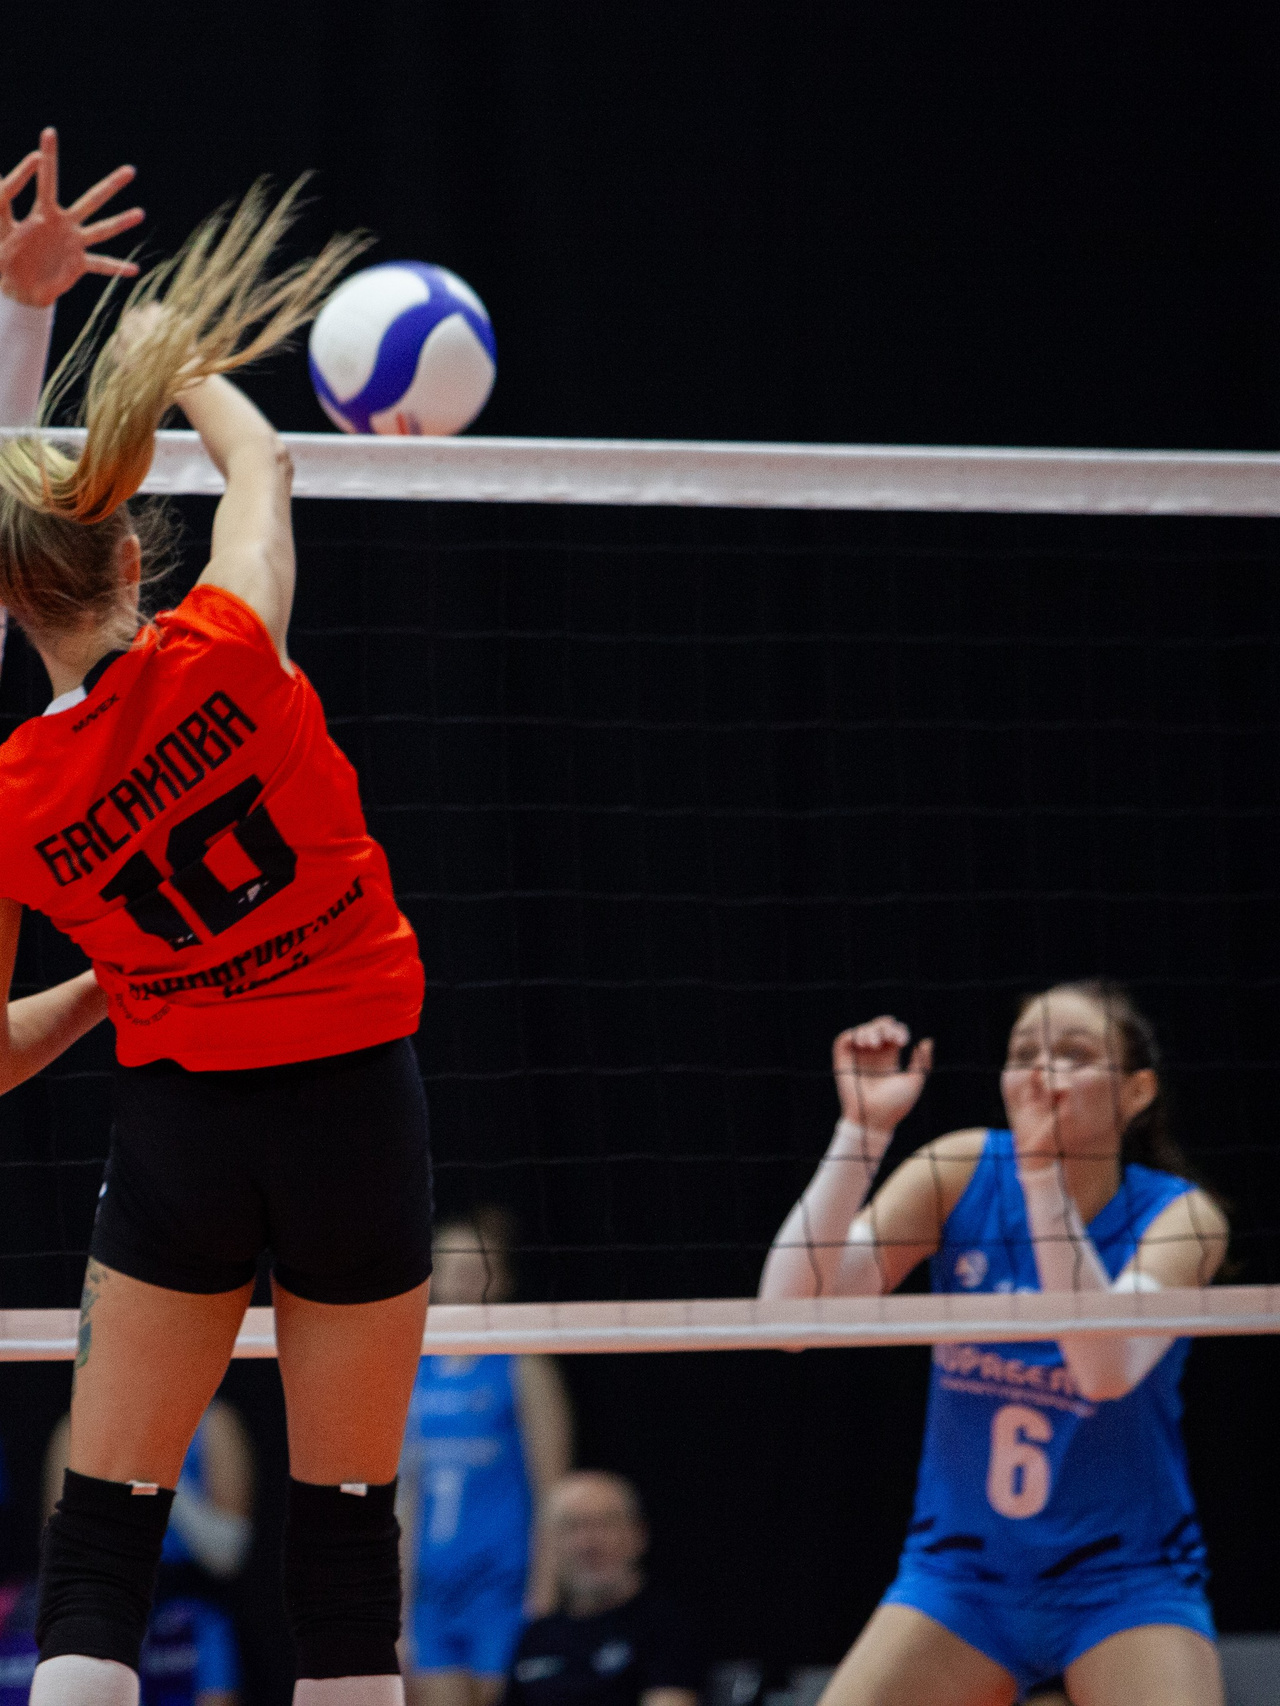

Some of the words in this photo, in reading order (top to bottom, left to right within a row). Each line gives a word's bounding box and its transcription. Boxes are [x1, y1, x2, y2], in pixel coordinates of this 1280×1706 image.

[34, 690, 258, 886] БАСАКОВА
[98, 774, 298, 952] 10
[986, 1404, 1053, 1519] 6
